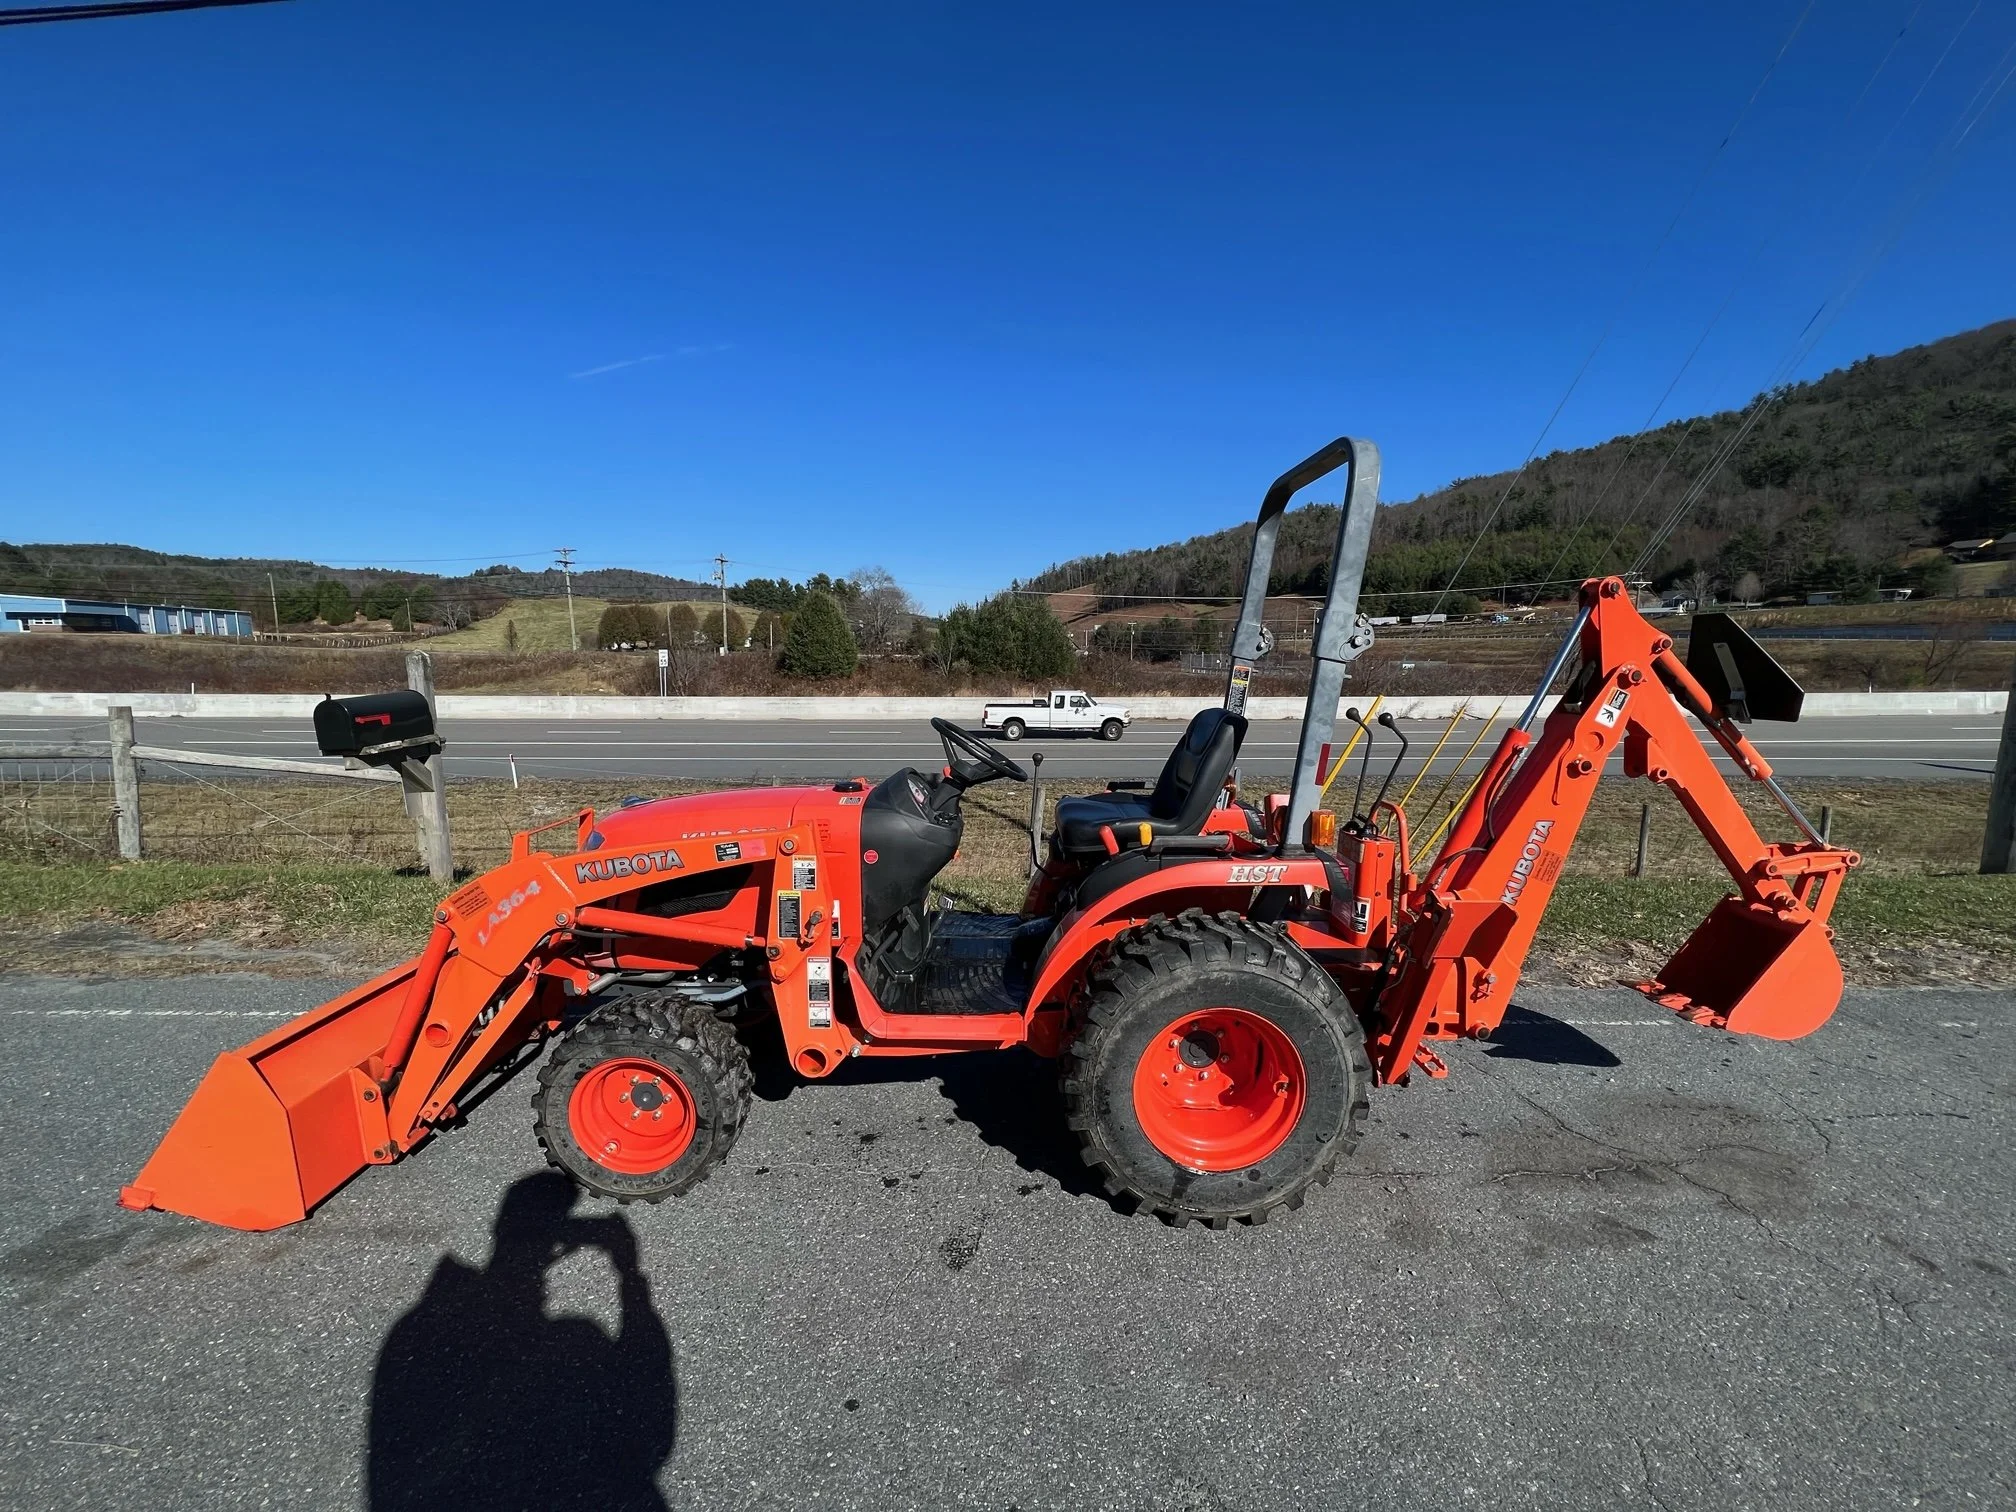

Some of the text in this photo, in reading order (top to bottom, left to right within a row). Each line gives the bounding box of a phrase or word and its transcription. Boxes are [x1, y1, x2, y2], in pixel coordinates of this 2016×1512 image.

[575, 849, 684, 883] KUBOTA
[1227, 865, 1288, 884] HST
[1500, 820, 1555, 906] KUBOTA
[477, 880, 541, 947] LA364
